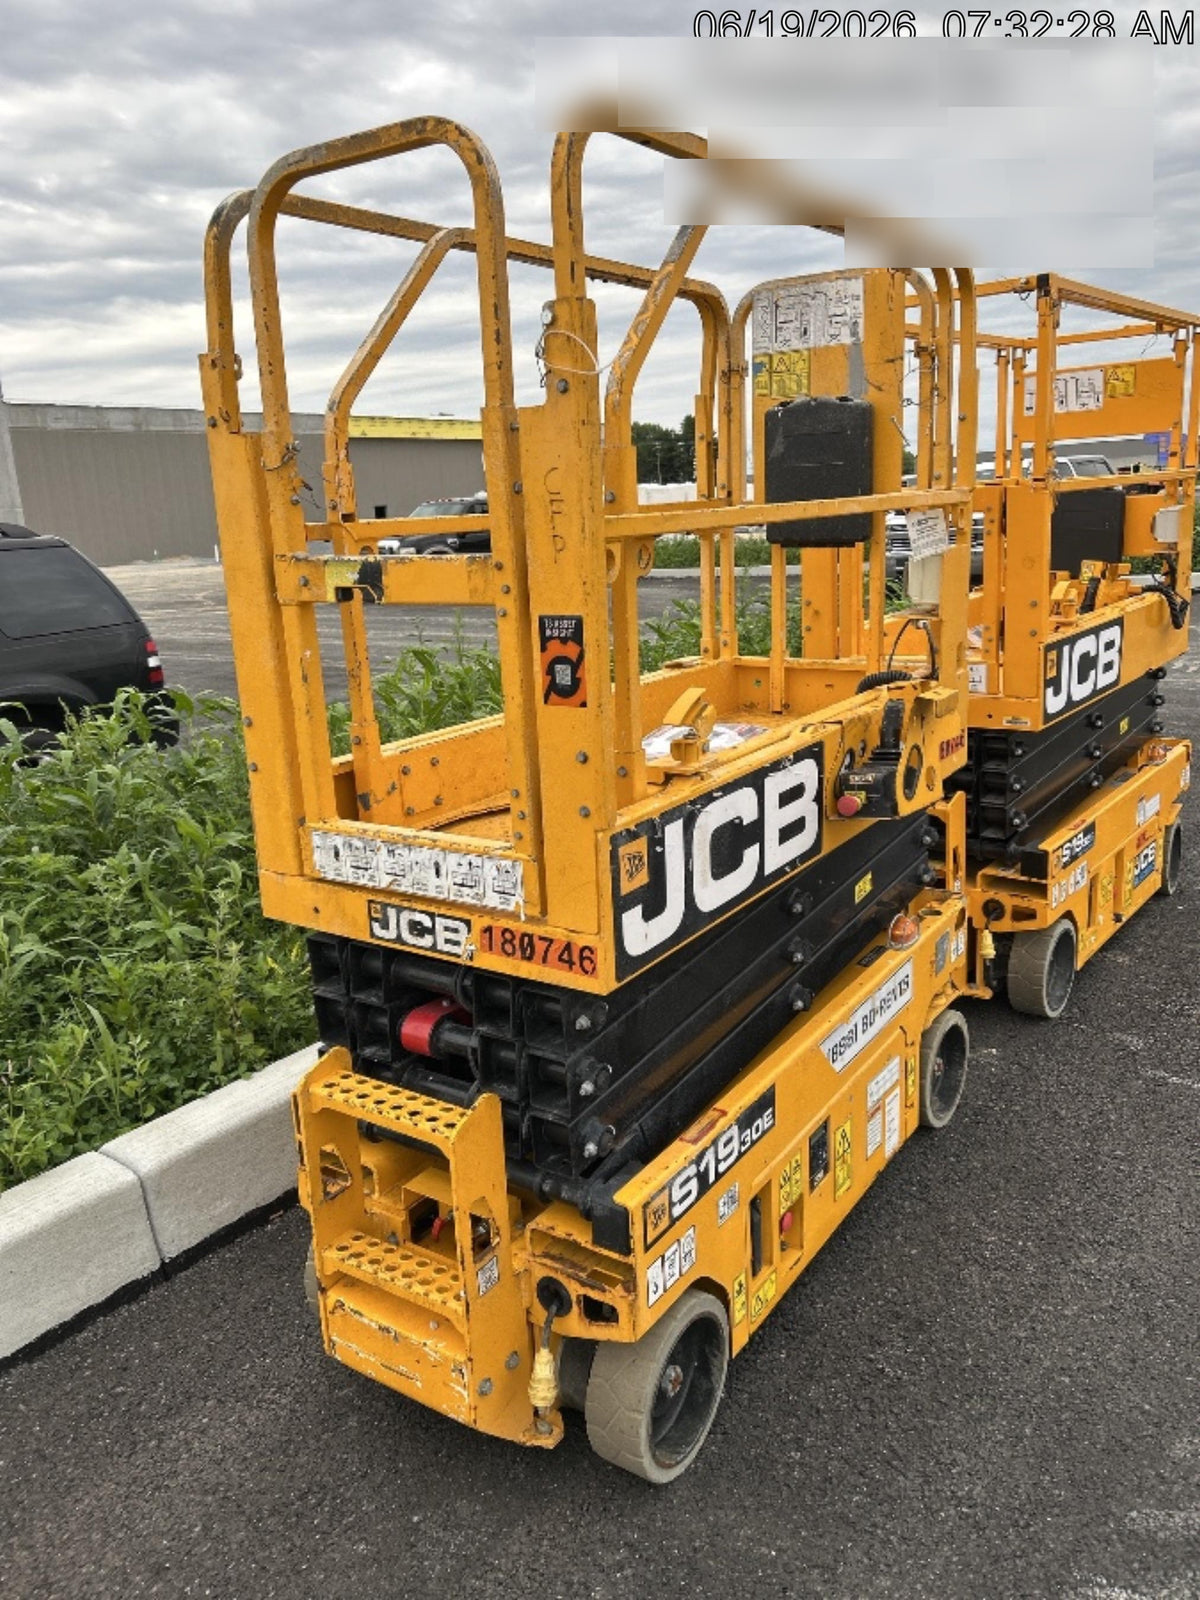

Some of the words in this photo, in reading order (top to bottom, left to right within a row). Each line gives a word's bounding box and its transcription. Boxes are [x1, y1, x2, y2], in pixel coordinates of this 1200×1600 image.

[1045, 624, 1122, 714] JCB
[621, 757, 820, 957] JCB
[371, 904, 472, 956] JCB
[481, 925, 598, 976] 180746
